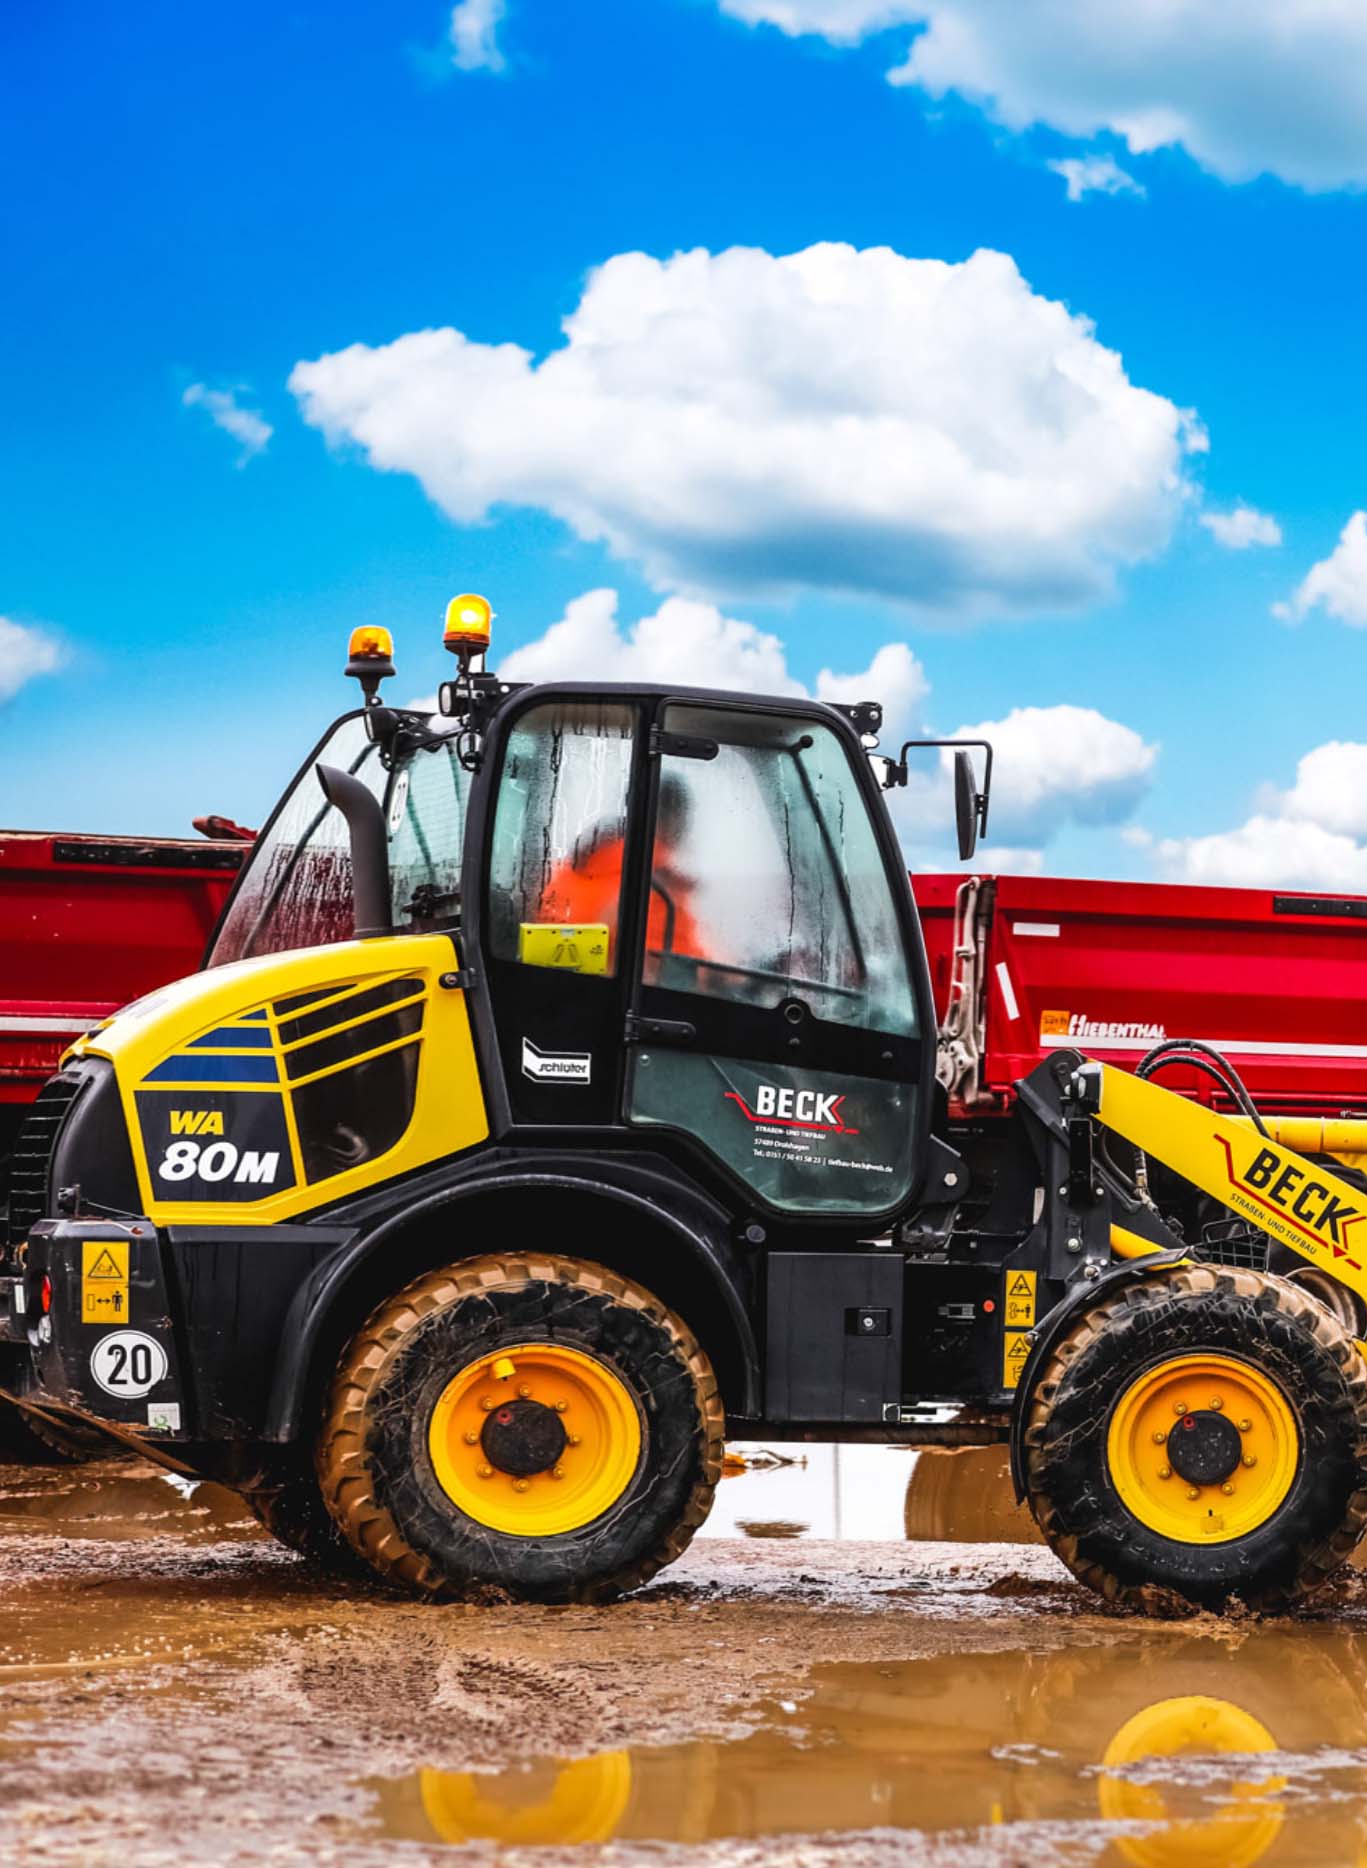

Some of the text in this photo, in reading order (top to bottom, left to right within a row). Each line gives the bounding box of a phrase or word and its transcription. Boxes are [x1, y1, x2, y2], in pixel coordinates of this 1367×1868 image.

[169, 1110, 225, 1135] WA
[756, 1085, 840, 1125] BECK
[158, 1140, 280, 1184] 80M
[1243, 1147, 1360, 1244] BECK
[1266, 1217, 1286, 1235] UND
[1285, 1230, 1318, 1255] TIEFBAU
[107, 1343, 152, 1385] 20
